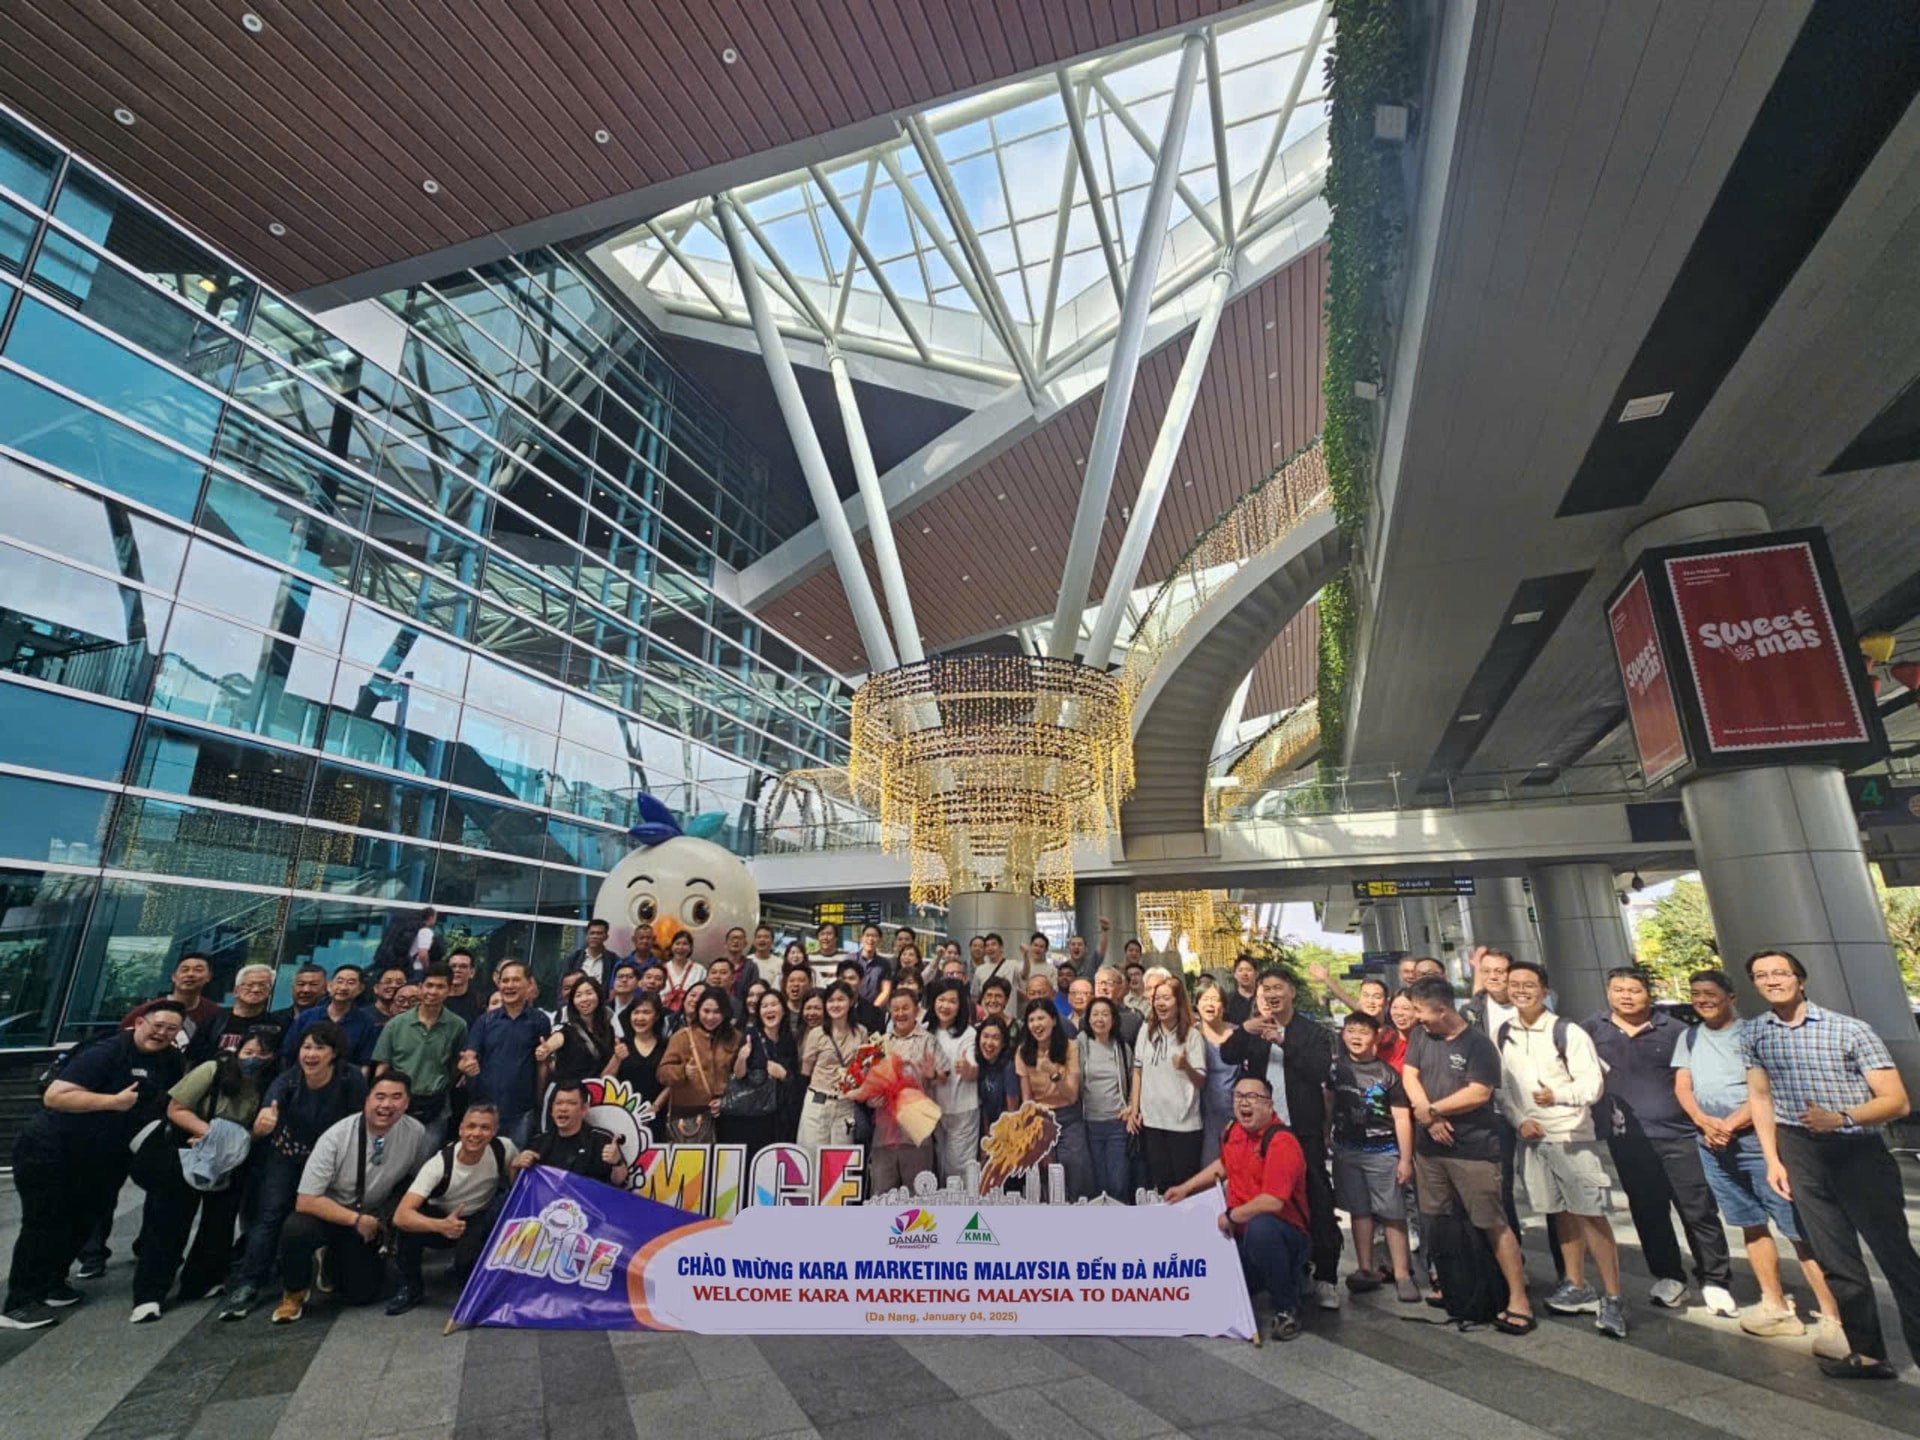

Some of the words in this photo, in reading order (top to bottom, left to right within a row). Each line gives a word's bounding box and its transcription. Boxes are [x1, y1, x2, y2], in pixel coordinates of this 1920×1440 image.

[1755, 627, 1822, 658] mas
[1860, 780, 1883, 806] 4
[637, 1144, 865, 1218] MICE
[888, 1233, 938, 1245] DANANG
[964, 1232, 993, 1242] KMM
[678, 1252, 726, 1278] CHÀO
[732, 1256, 793, 1280] MỪNG
[798, 1259, 848, 1280] KARA
[855, 1259, 967, 1280] MARKETING
[974, 1259, 1071, 1280] MALAYSIA
[1076, 1255, 1117, 1280] ĐẾN
[1122, 1256, 1147, 1280] ĐÀ
[1153, 1252, 1206, 1280] NẴNG
[692, 1285, 792, 1303] WELCOME
[799, 1287, 849, 1303] KARA
[856, 1287, 970, 1303] MARKETING
[977, 1287, 1074, 1303] MALAYSIA
[1080, 1287, 1106, 1303] TO
[1112, 1286, 1190, 1303] DANANG
[864, 1311, 885, 1324] (Da
[888, 1312, 919, 1324] Nang,
[922, 1311, 966, 1324] January
[970, 1312, 987, 1323] 04,
[989, 1311, 1019, 1324] 2025)
